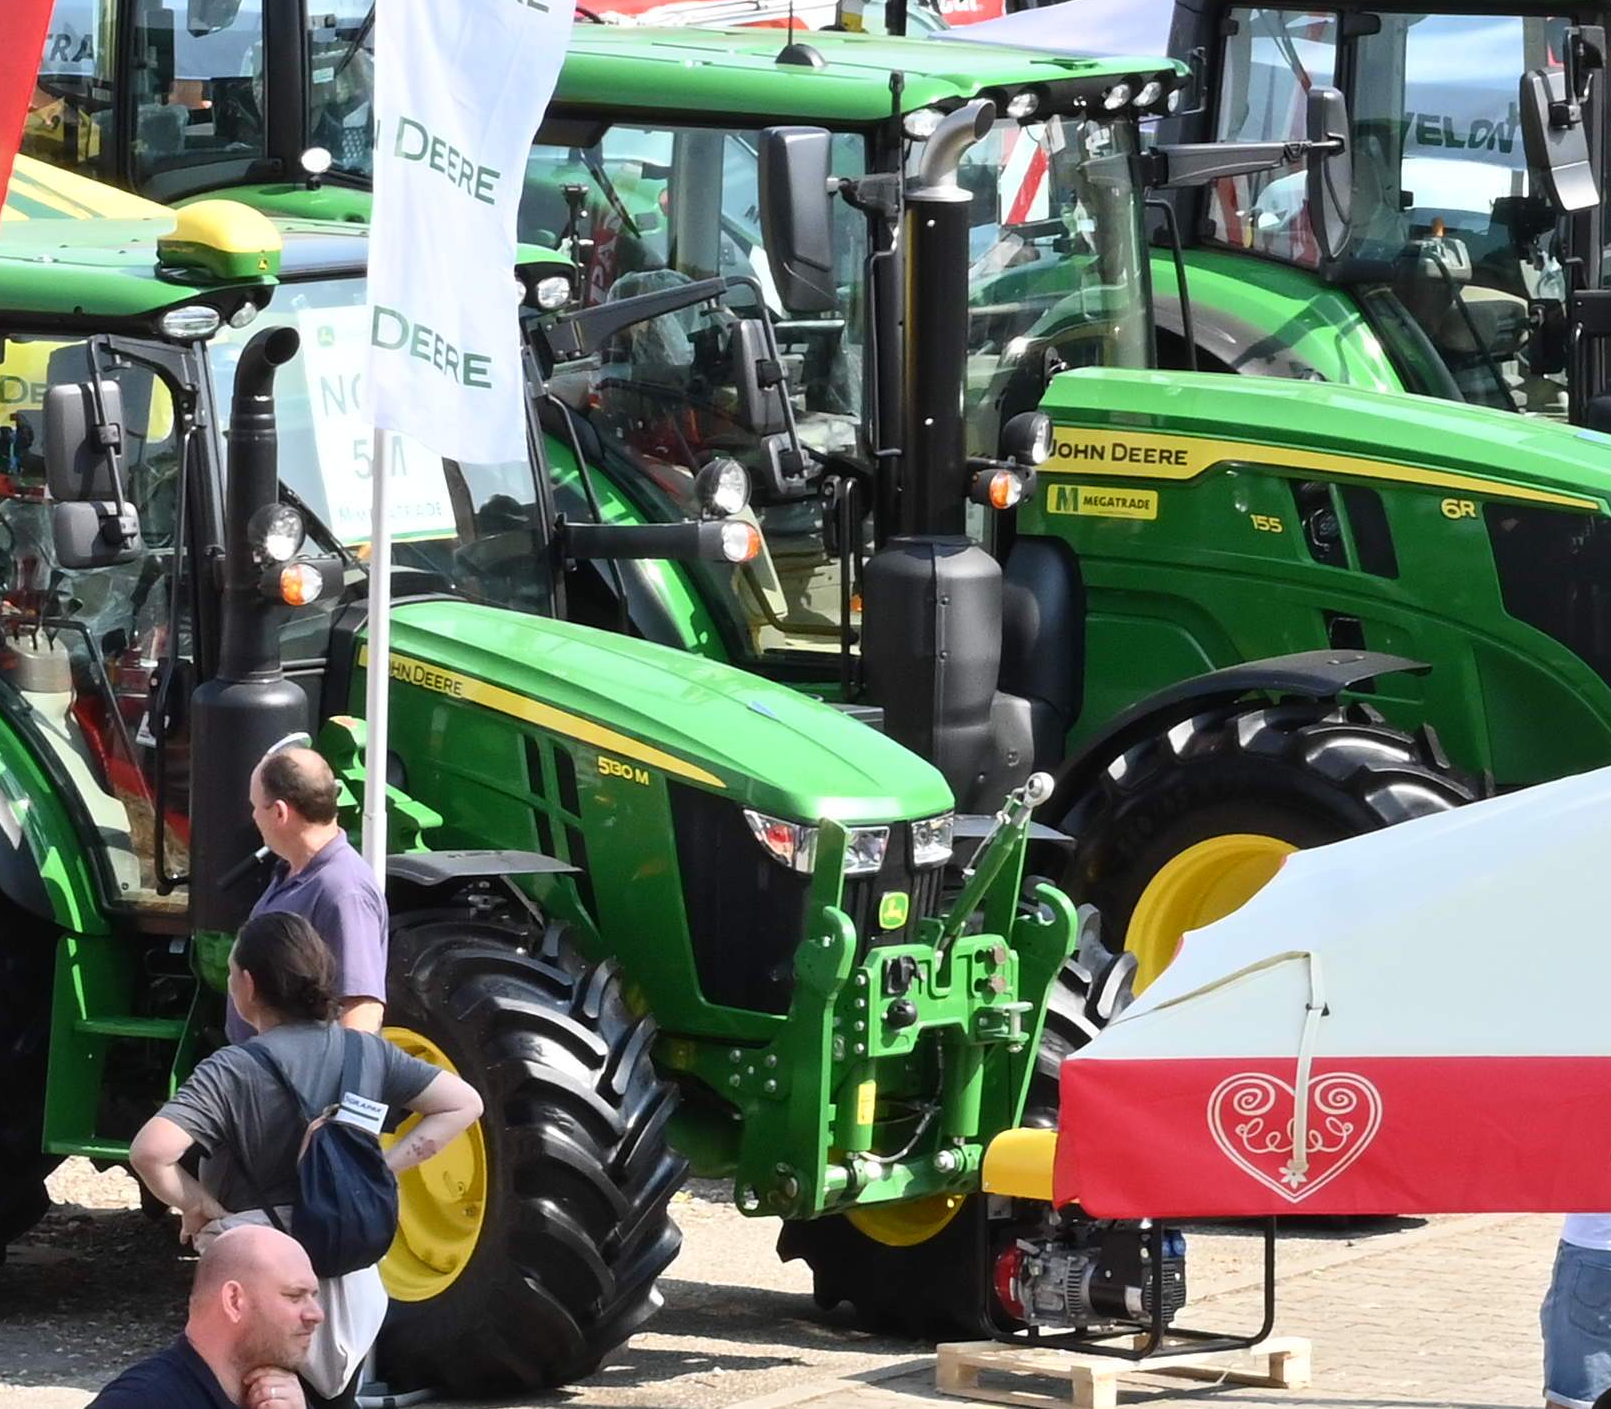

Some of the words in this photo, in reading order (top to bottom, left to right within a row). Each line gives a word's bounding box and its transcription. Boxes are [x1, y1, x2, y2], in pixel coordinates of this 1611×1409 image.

[394, 116, 502, 206] DEERE
[370, 304, 493, 389] DEERE
[1049, 439, 1106, 462] JOHN
[1110, 442, 1189, 467] DEERE
[1082, 494, 1151, 511] MEGATRADE
[1440, 497, 1476, 520] 6R
[1250, 512, 1283, 534] 155
[412, 663, 464, 697] DEERE
[597, 756, 634, 782] 5130
